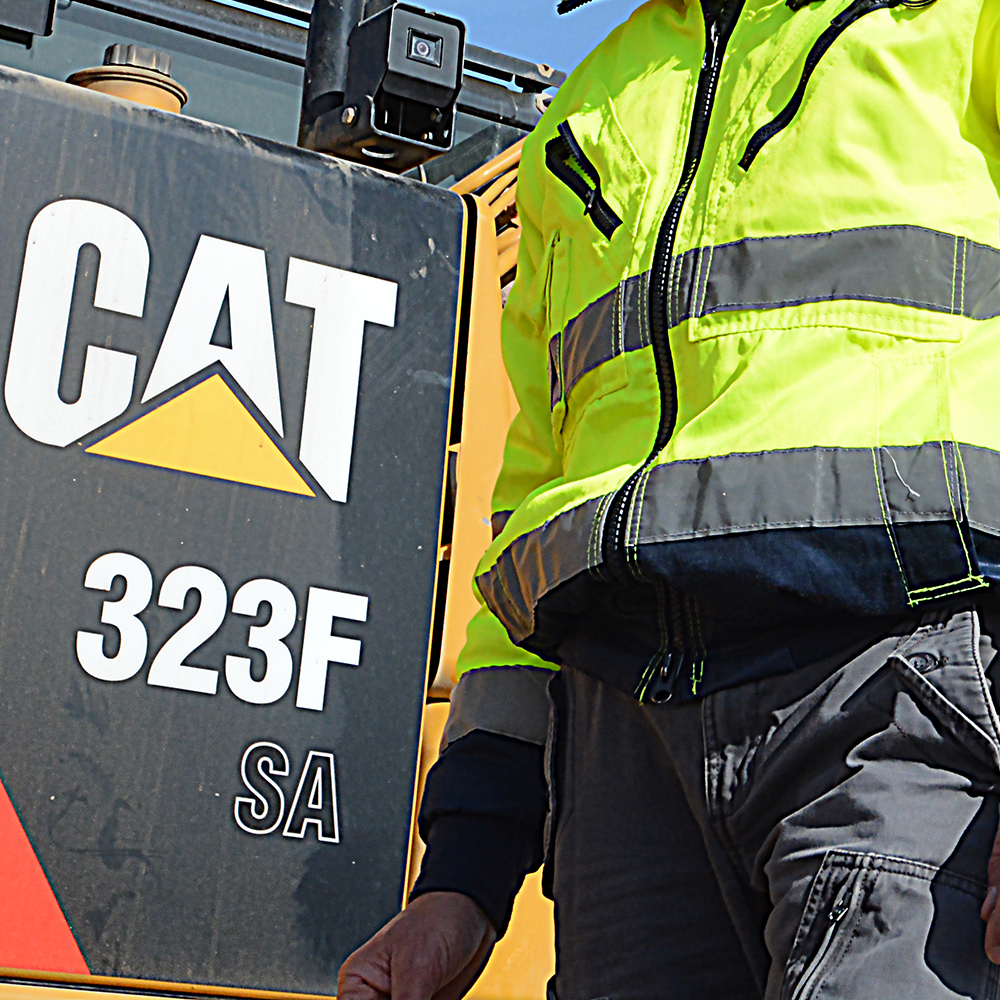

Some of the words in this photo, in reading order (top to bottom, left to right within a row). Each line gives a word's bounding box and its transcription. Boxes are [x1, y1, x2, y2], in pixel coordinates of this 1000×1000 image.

[4, 199, 398, 503] CAT
[75, 552, 369, 711] 323F
[234, 741, 340, 844] SA
